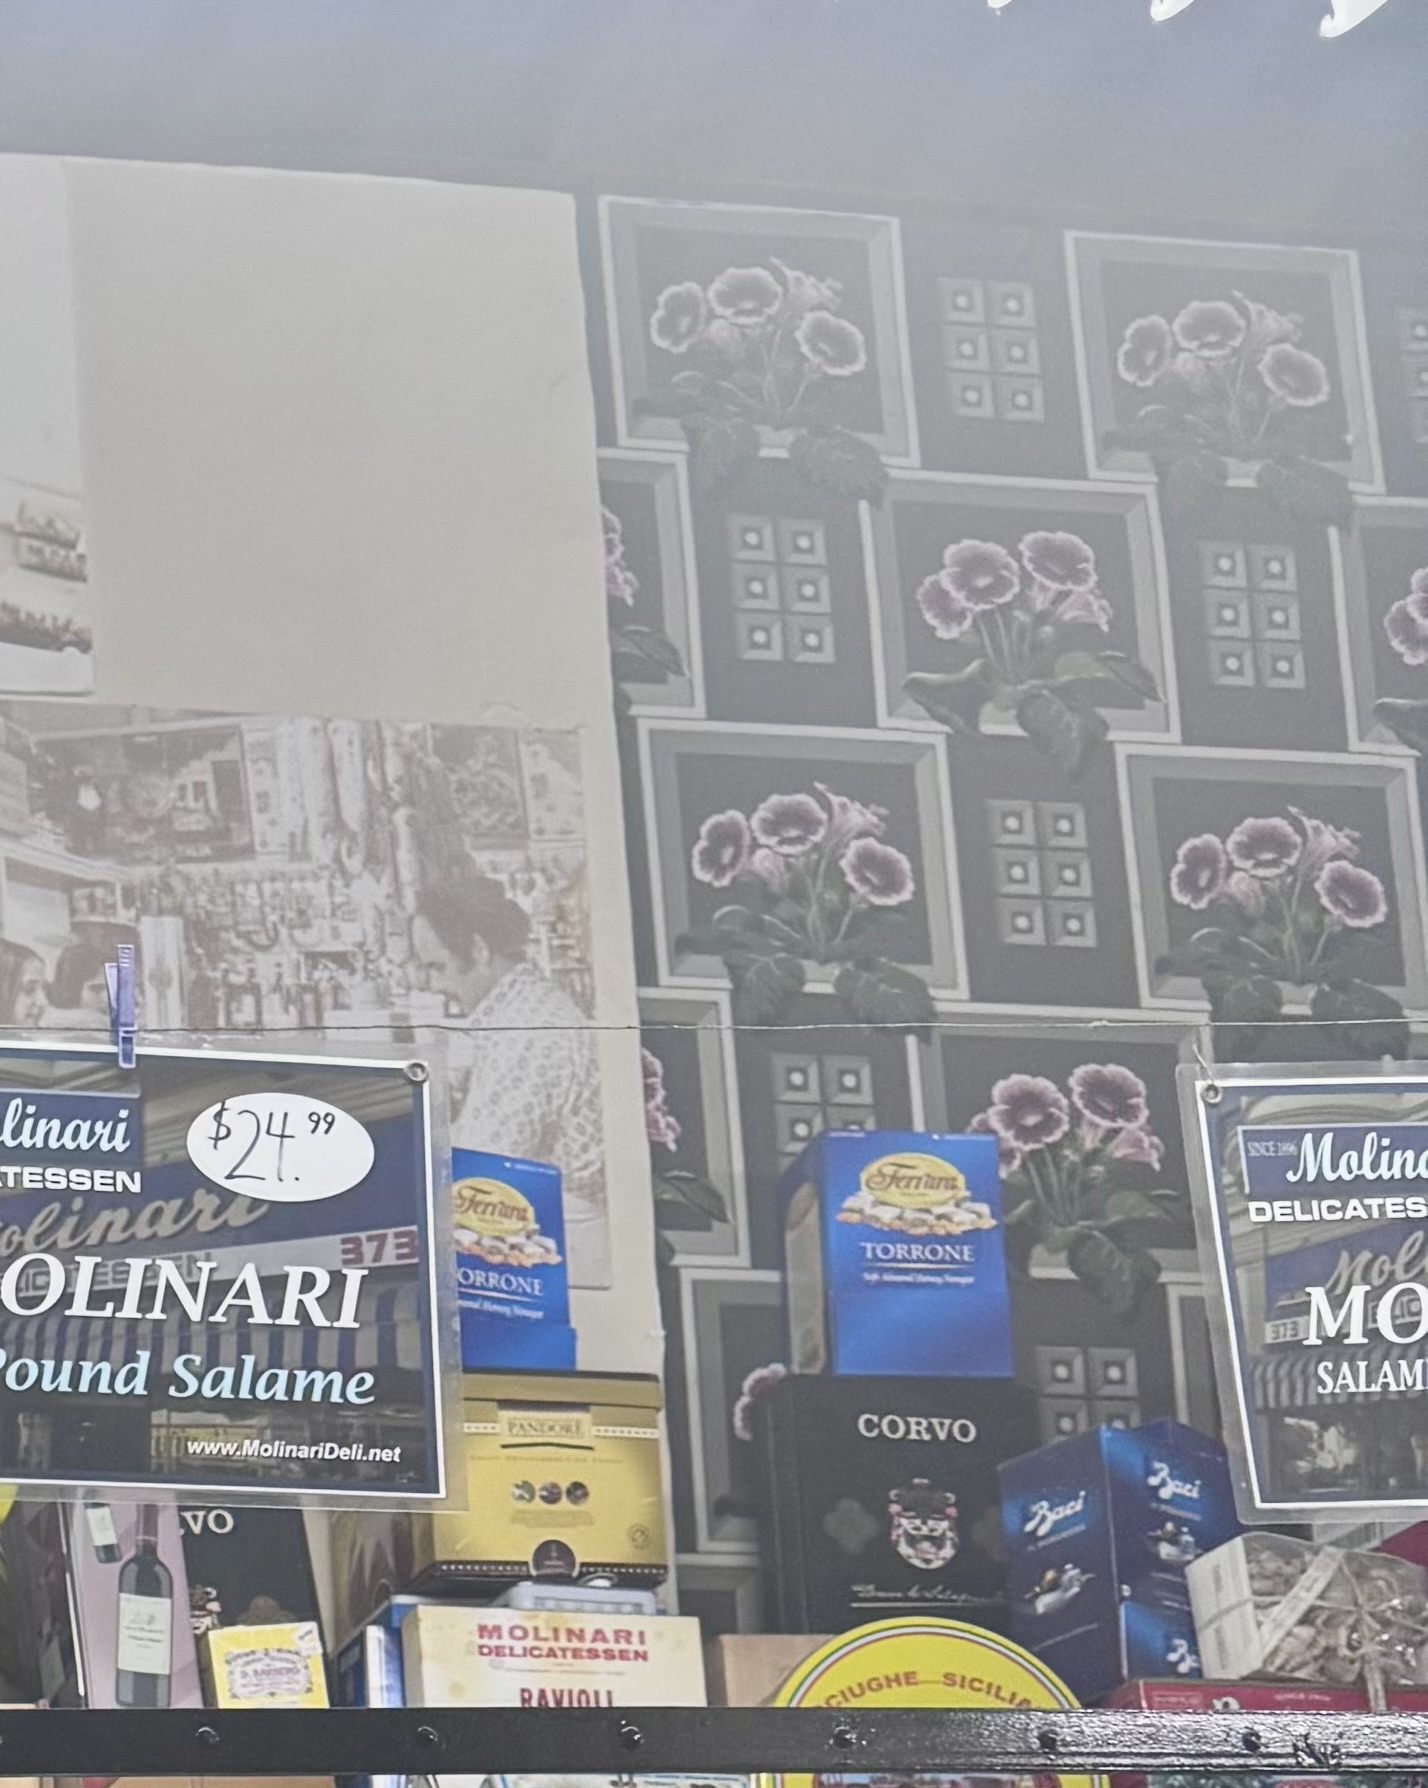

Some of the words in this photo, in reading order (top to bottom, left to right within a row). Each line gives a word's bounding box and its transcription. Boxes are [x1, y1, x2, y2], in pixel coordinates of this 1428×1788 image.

[865, 1160, 959, 1197] Ferrara
[341, 1230, 417, 1267] 373
[860, 1241, 976, 1265] TORRONE
[458, 1267, 543, 1296] ORRONE
[169, 1353, 375, 1404] Salame
[857, 1413, 977, 1444] CORVO
[187, 1438, 401, 1463] www.MolinariDeli.net
[1148, 1462, 1202, 1501] Baci
[1024, 1490, 1089, 1535] Baci
[477, 1624, 648, 1645] MOLINARI
[477, 1644, 648, 1663] DELICATESSEN
